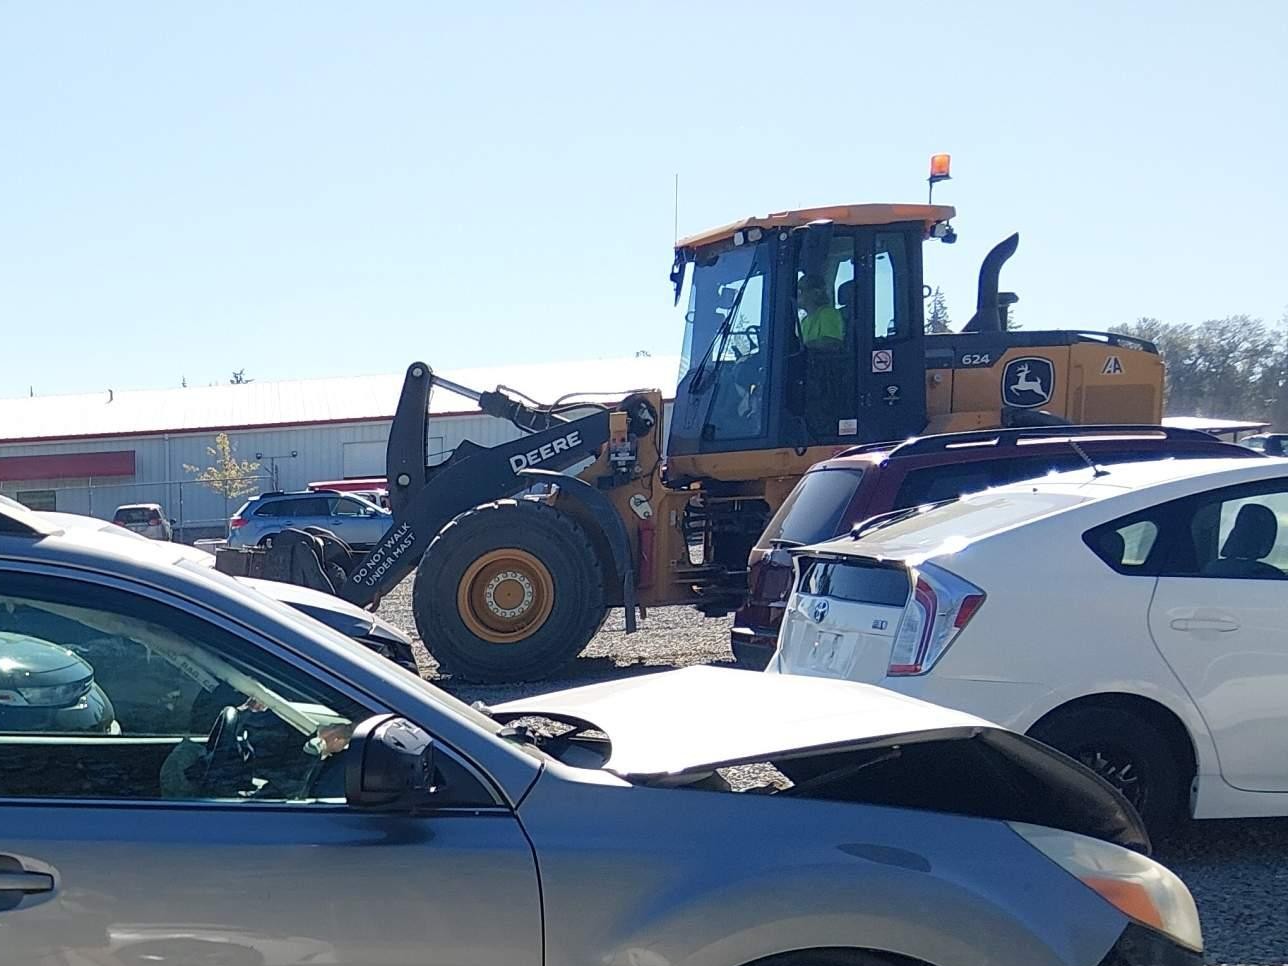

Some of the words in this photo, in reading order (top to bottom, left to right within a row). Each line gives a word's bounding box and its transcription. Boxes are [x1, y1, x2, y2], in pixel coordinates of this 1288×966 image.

[961, 353, 990, 365] 624
[509, 430, 582, 473] DEERE
[353, 568, 368, 584] DO
[366, 547, 386, 569] NOT
[384, 522, 411, 548] WALK
[365, 557, 395, 586] UNDER
[392, 532, 416, 558] MAST
